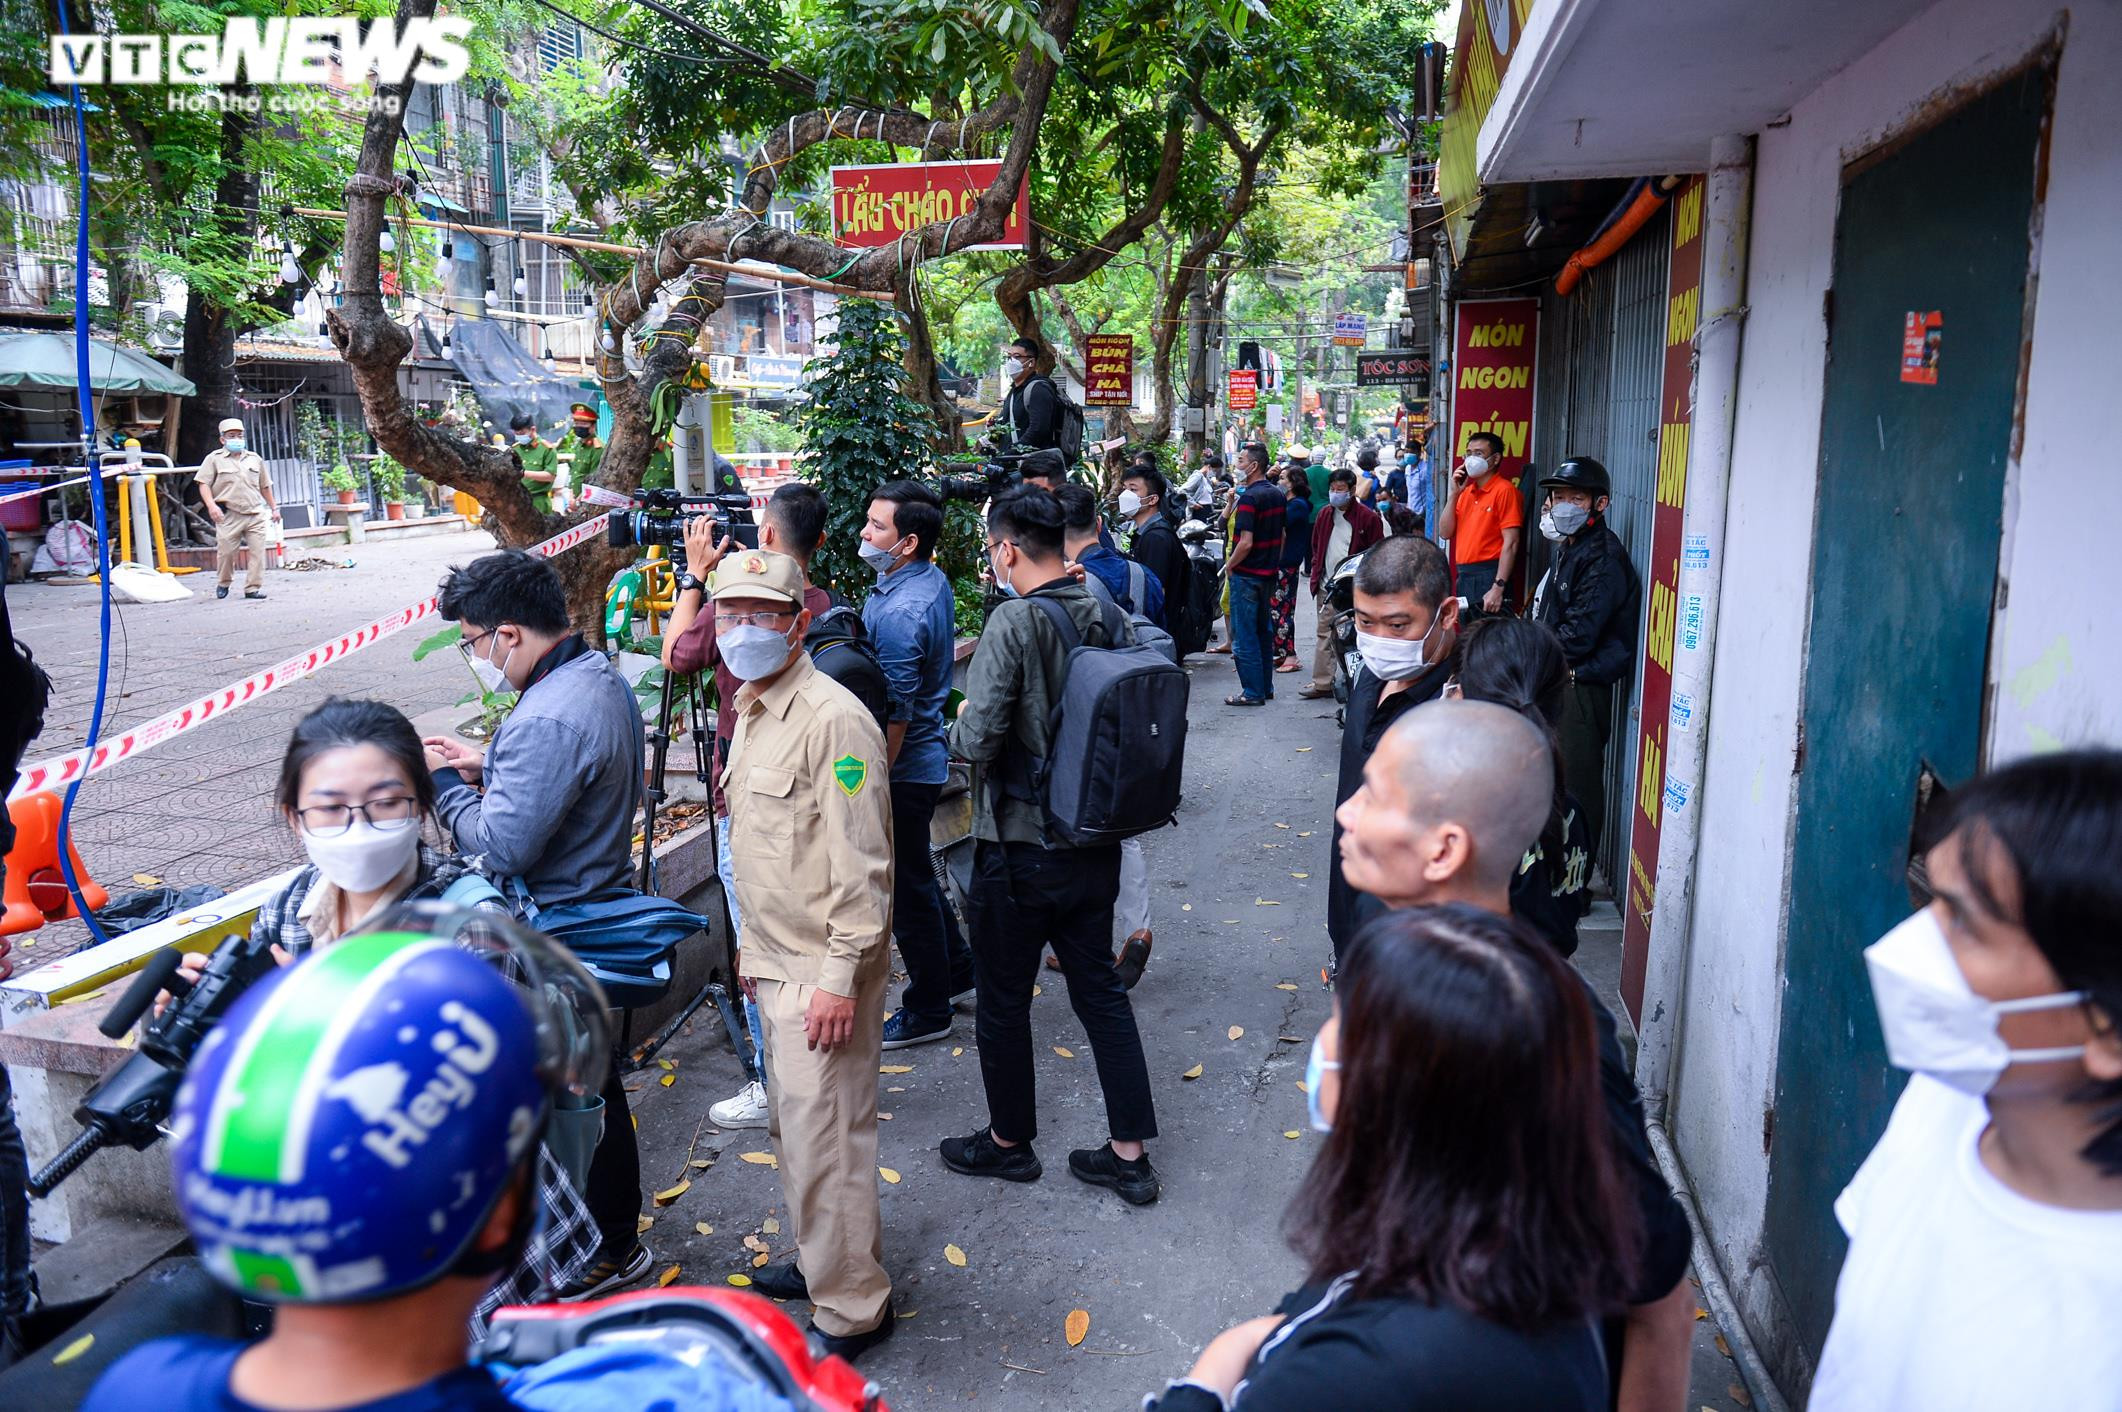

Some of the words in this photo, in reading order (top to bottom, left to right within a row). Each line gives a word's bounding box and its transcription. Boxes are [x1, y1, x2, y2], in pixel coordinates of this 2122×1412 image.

[890, 180, 954, 231] CHÁO
[1468, 318, 1525, 348] MÓN
[1667, 284, 1699, 347] NGON
[1090, 346, 1128, 358] BÚN
[1091, 361, 1126, 373] CHẢ
[1459, 366, 1530, 390] NGON
[1656, 397, 1690, 509] BÚN
[1649, 558, 1678, 676] CHẢ
[1685, 596, 1701, 650] 0967.296.613
